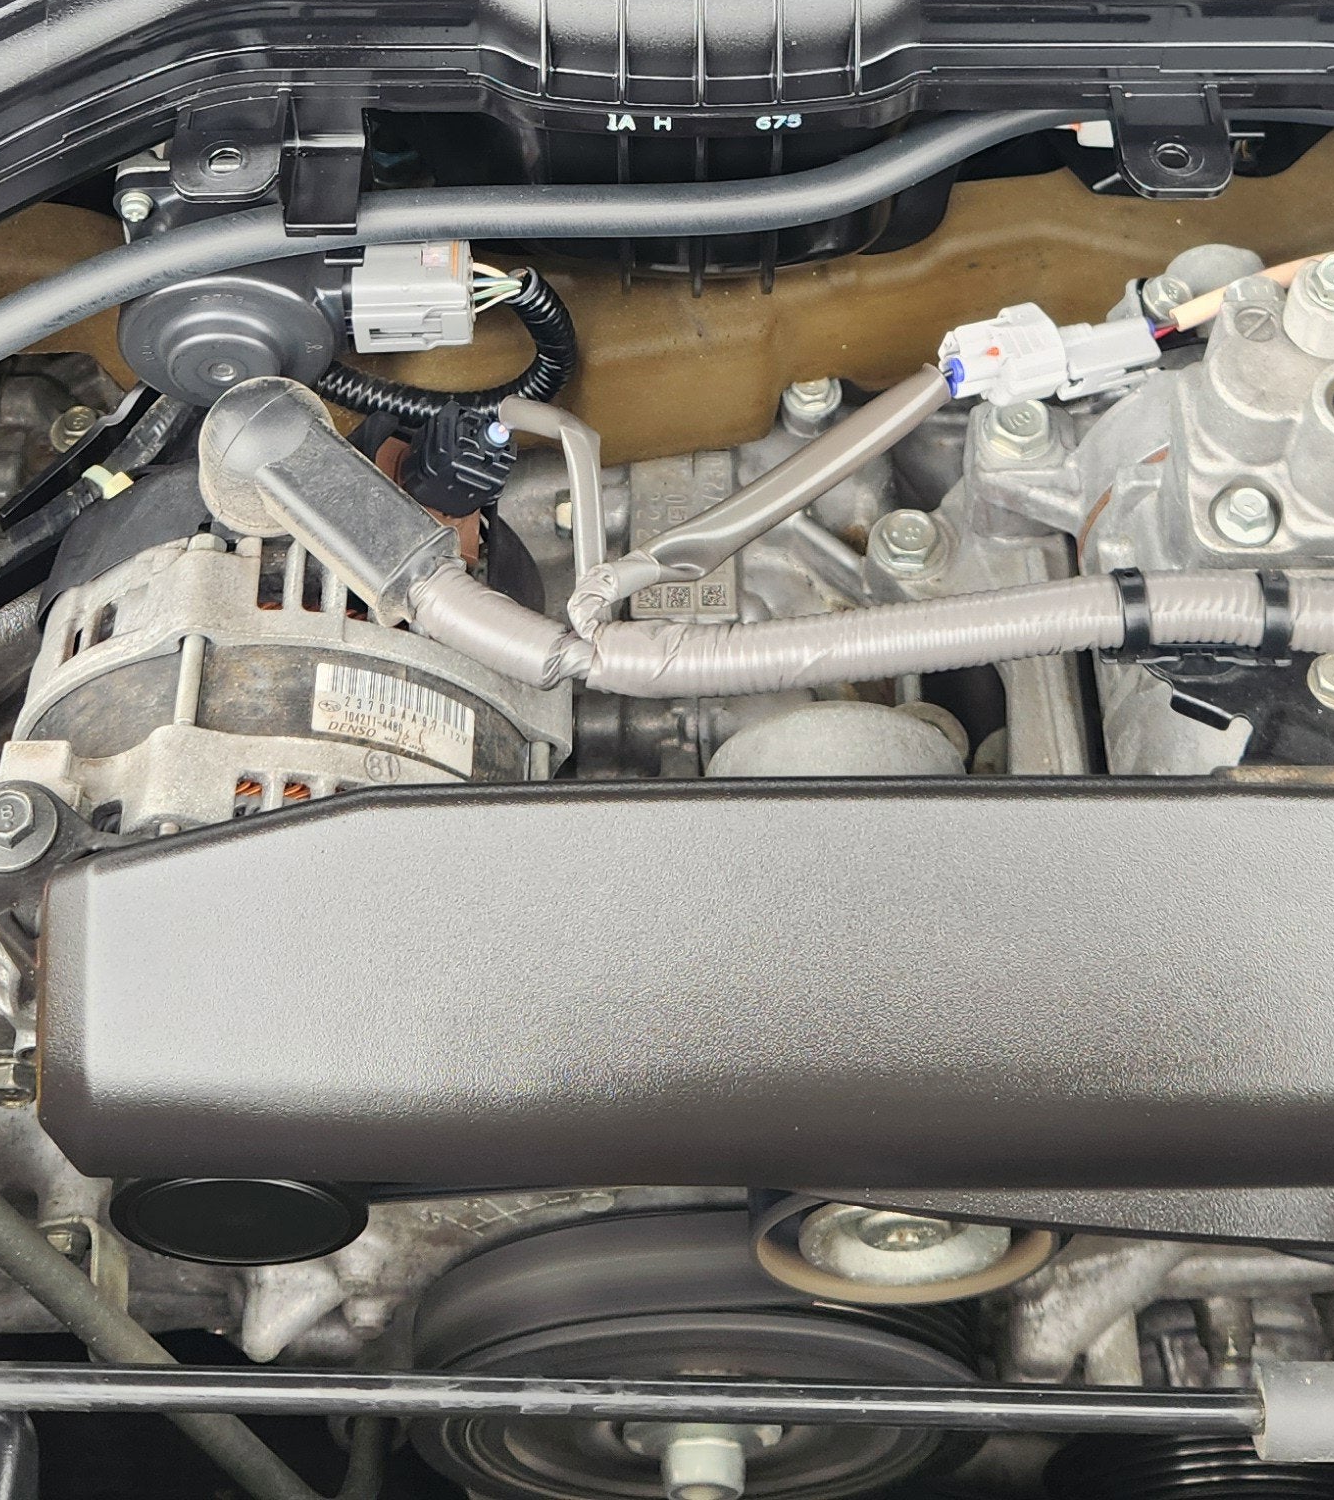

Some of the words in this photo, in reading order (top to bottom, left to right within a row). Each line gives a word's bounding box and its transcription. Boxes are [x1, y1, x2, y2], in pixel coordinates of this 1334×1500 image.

[653, 115, 672, 132] H
[755, 113, 803, 130] 675
[327, 721, 377, 738] DENSO
